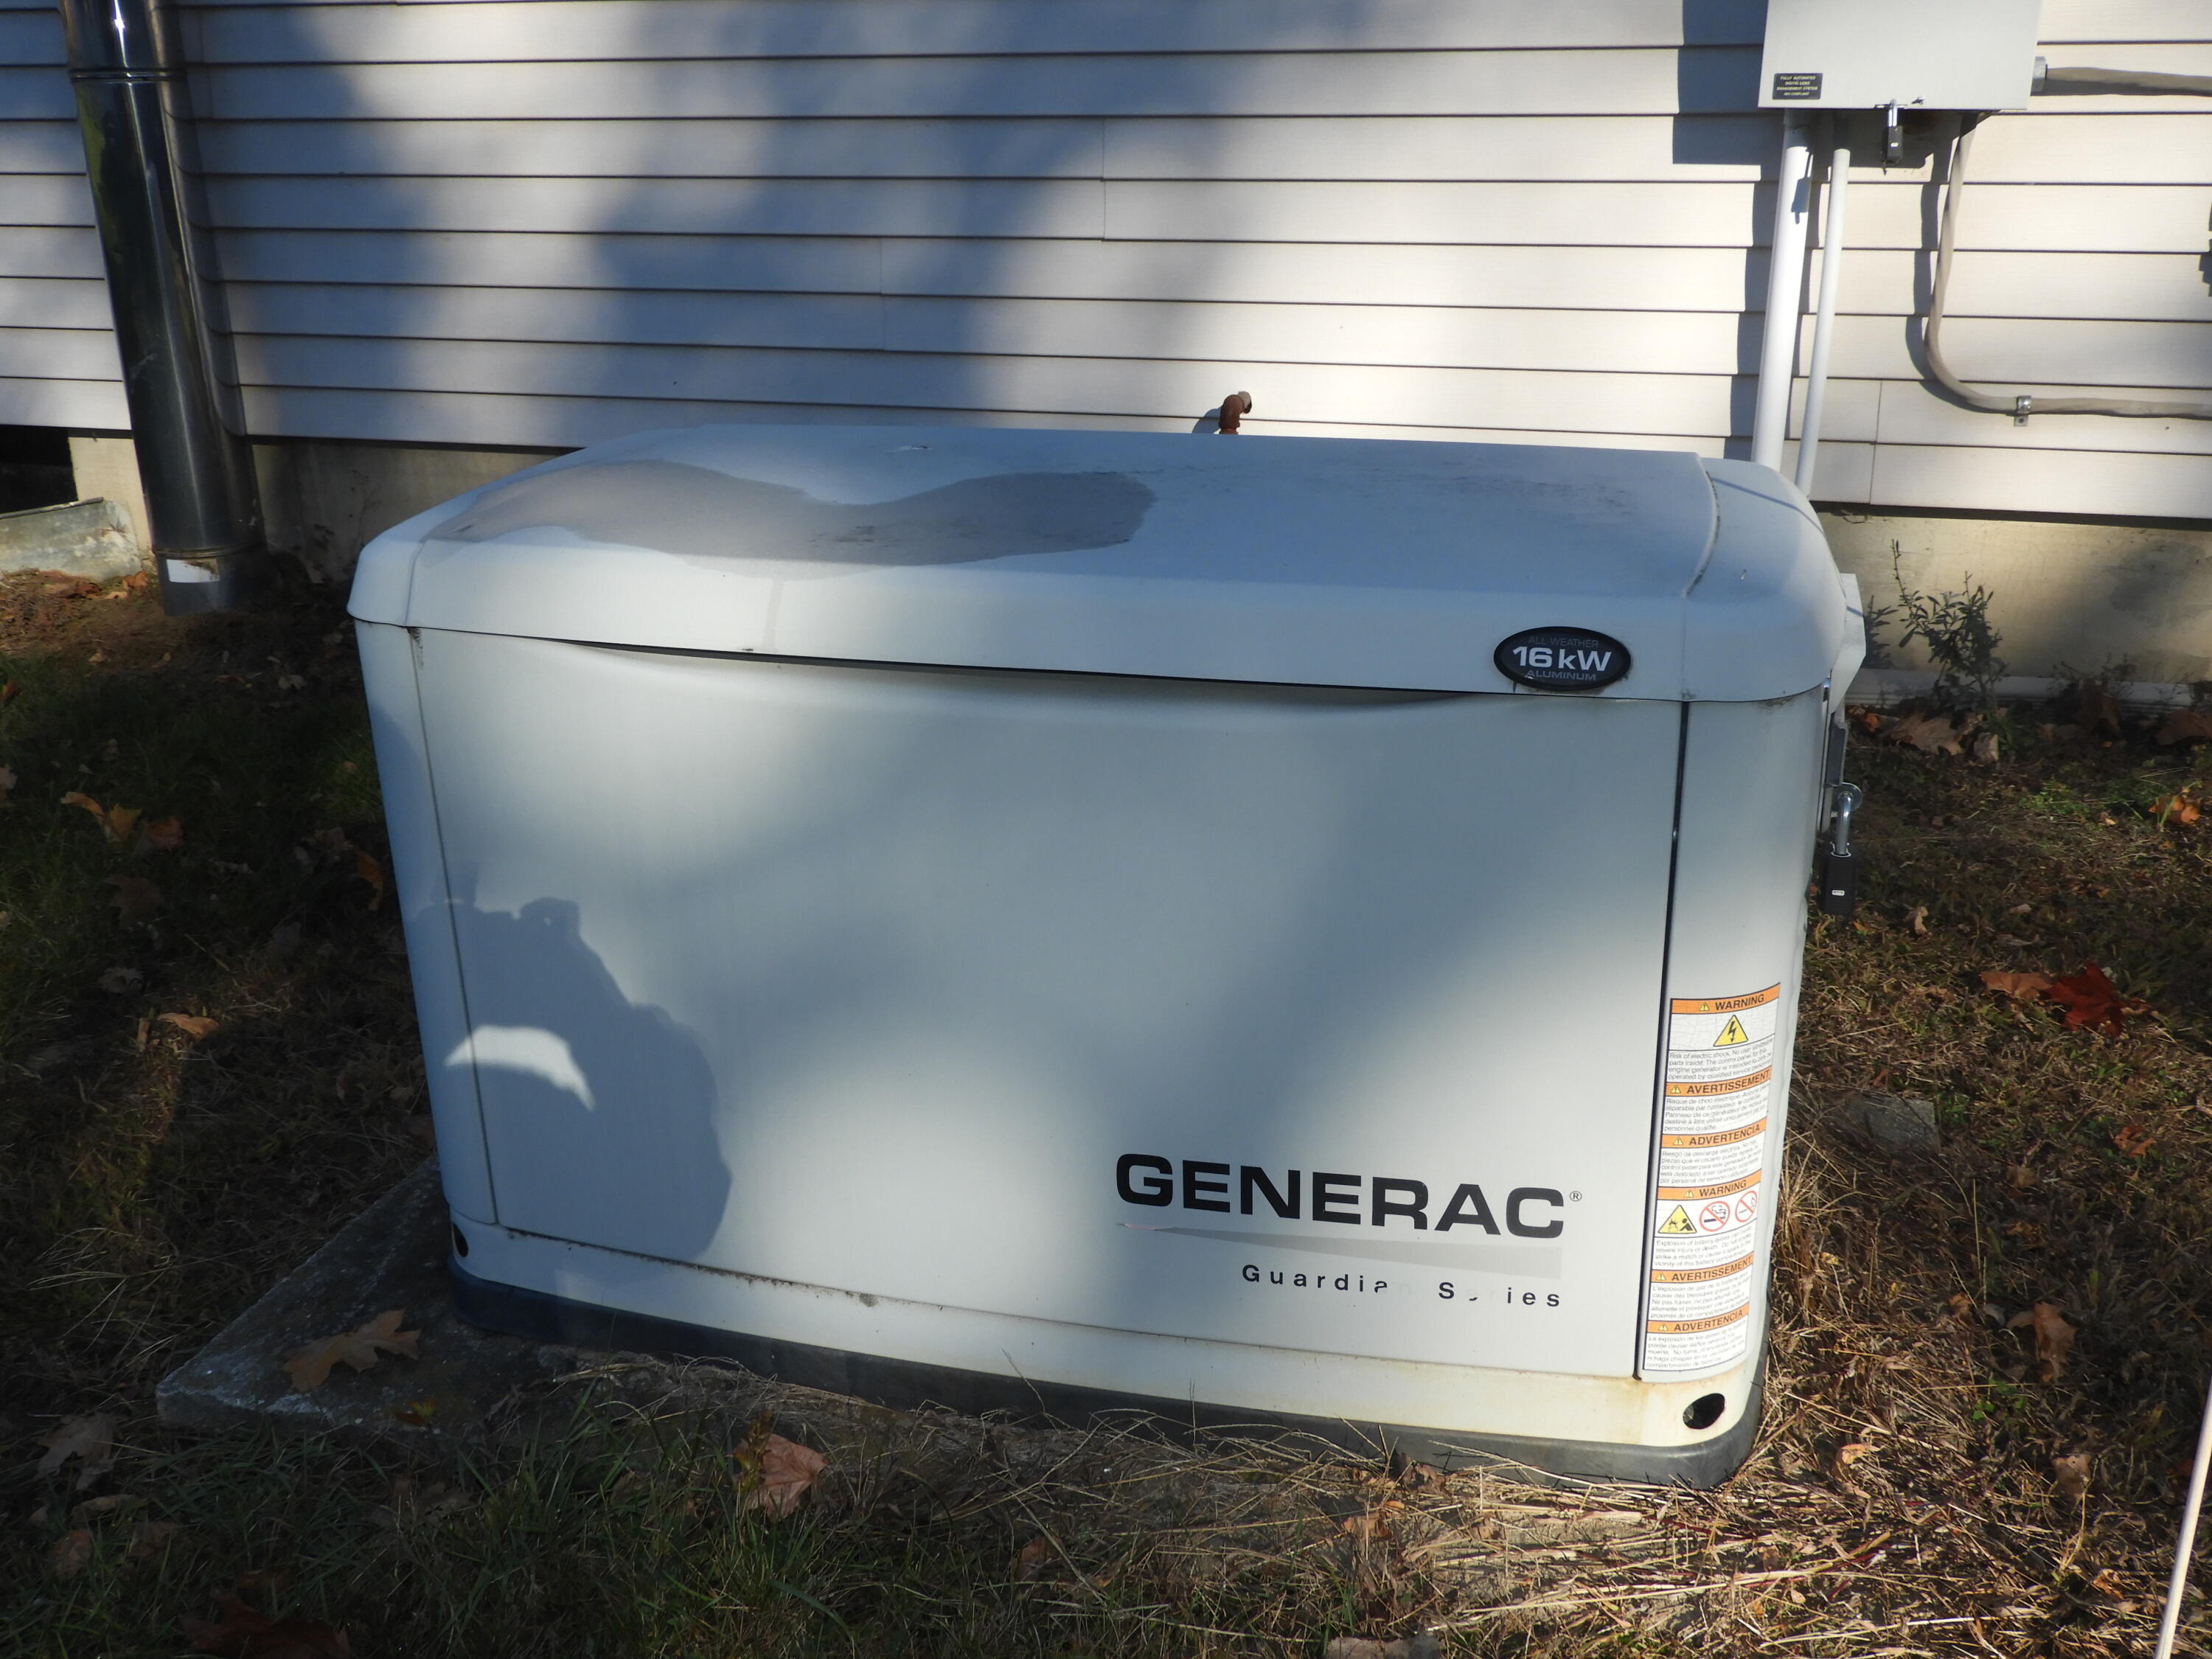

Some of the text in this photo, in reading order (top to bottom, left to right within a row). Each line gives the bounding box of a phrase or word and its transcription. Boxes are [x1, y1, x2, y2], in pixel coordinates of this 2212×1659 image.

[1512, 646, 1612, 672] 16 kW
[1526, 669, 1596, 681] ALUMINUM
[1715, 994, 1764, 1011] WARNING
[1691, 1065, 1721, 1074] generator
[1686, 1070, 1770, 1093] AVERTISSEMENT
[1688, 1124, 1760, 1146] ADVERTENCIA
[1116, 1153, 1564, 1239] GENERAC
[1699, 1180, 1747, 1197] WARNING
[1672, 1256, 1752, 1281] AVERTISSEMENT
[1439, 1281, 1559, 1307] Sies
[1674, 1310, 1743, 1332] ADVERTENCIA
